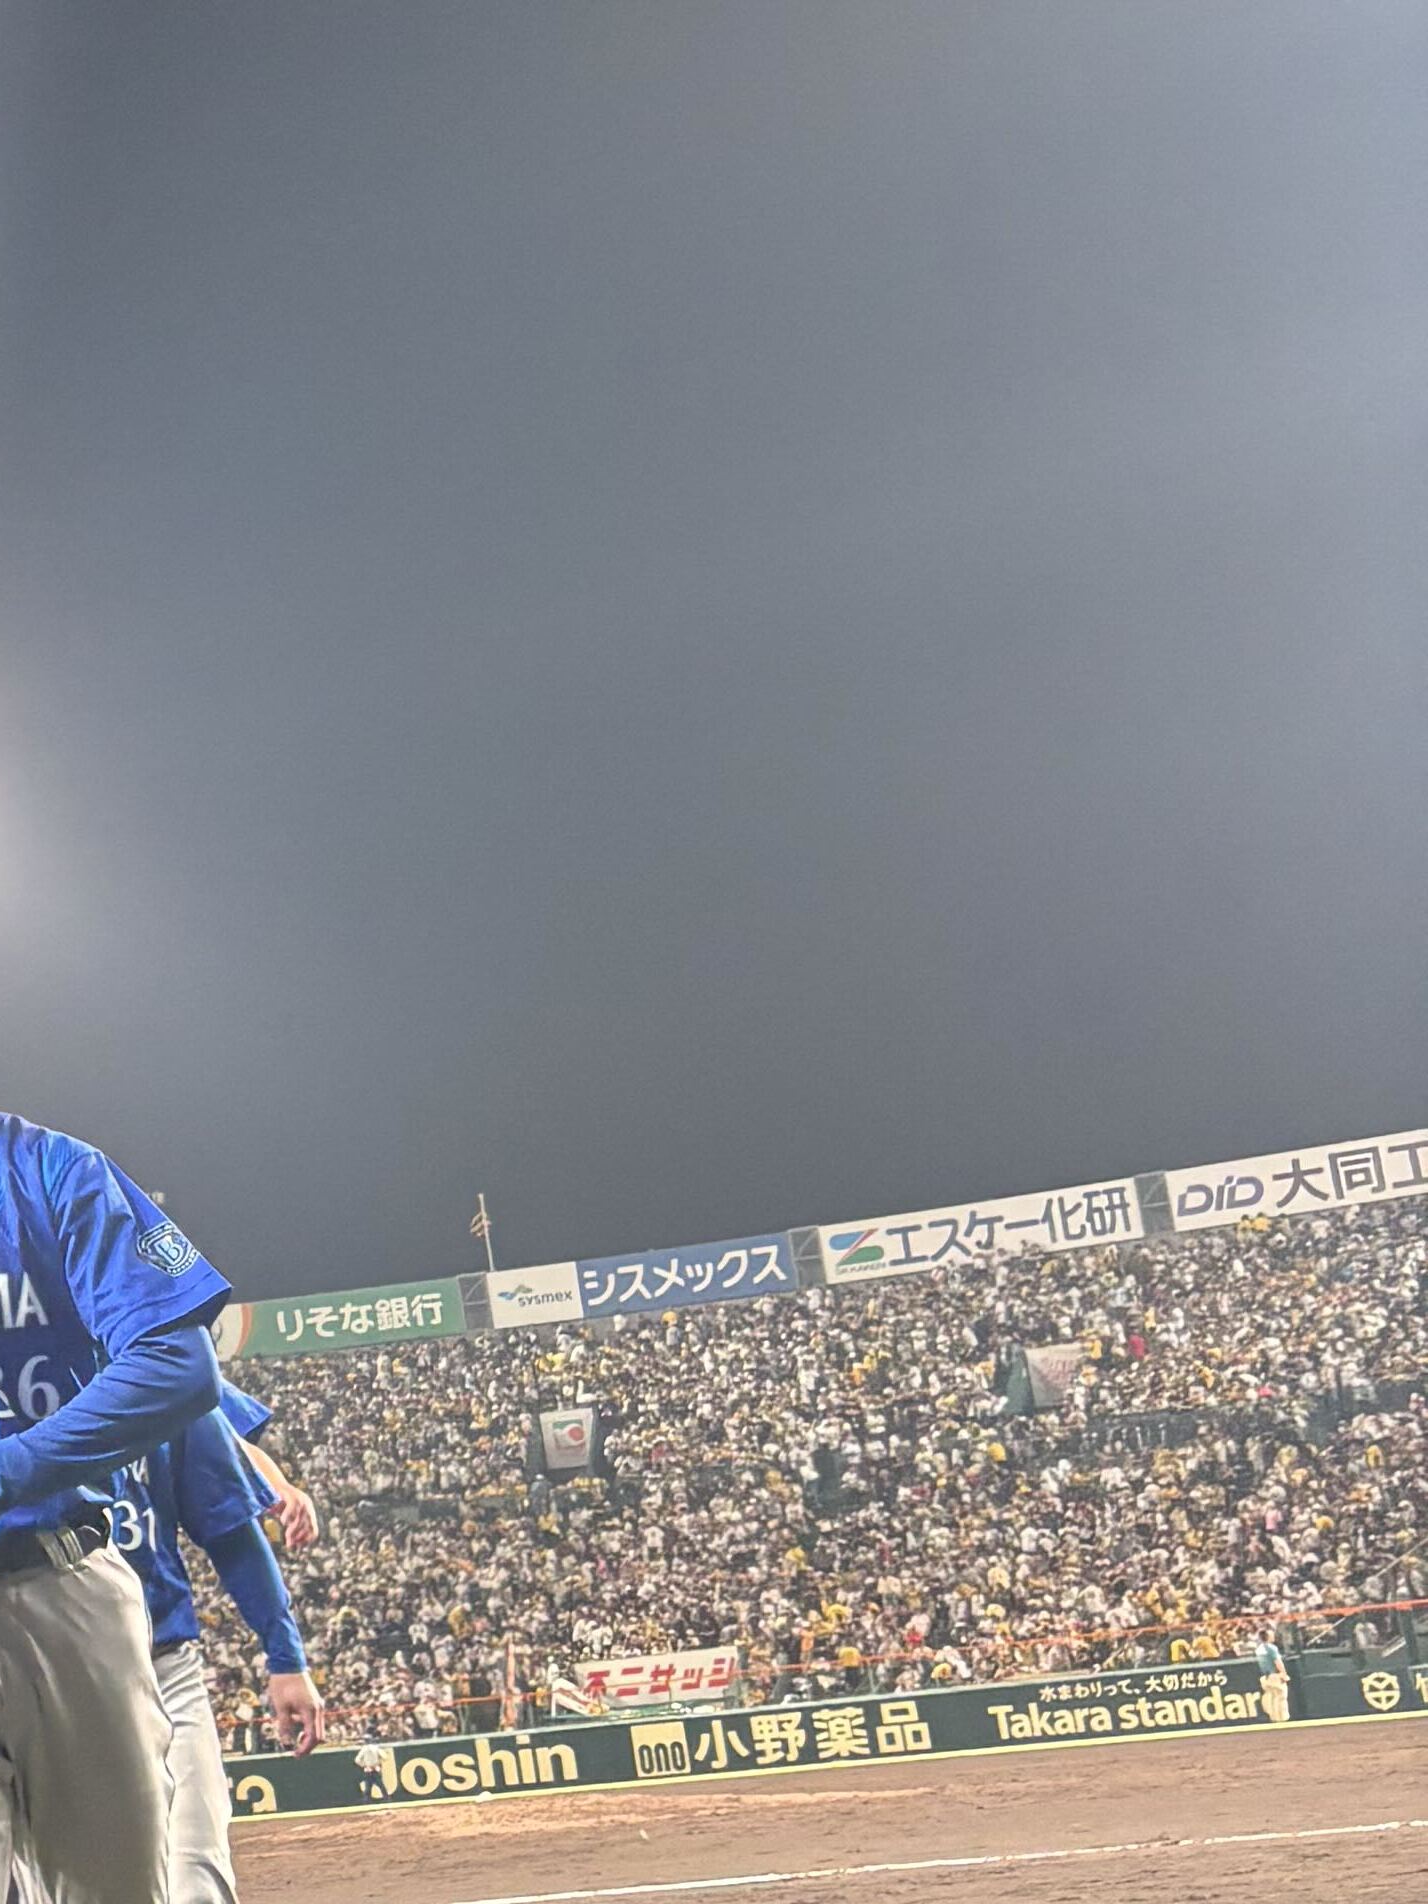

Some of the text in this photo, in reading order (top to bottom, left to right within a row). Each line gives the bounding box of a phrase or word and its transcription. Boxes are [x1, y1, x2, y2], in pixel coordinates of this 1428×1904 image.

[1272, 1140, 1428, 1208] 大同工
[885, 1186, 1131, 1267] エスケー化研
[518, 1245, 789, 1307] sysmex シスメックス
[276, 1292, 443, 1342] りそな銀行
[113, 1500, 158, 1552] 31
[583, 1657, 736, 1698] 不二サッシ
[694, 1701, 933, 1769] 小野薬品
[987, 1686, 1261, 1740] Takara standar
[360, 1734, 578, 1798] Joshin
